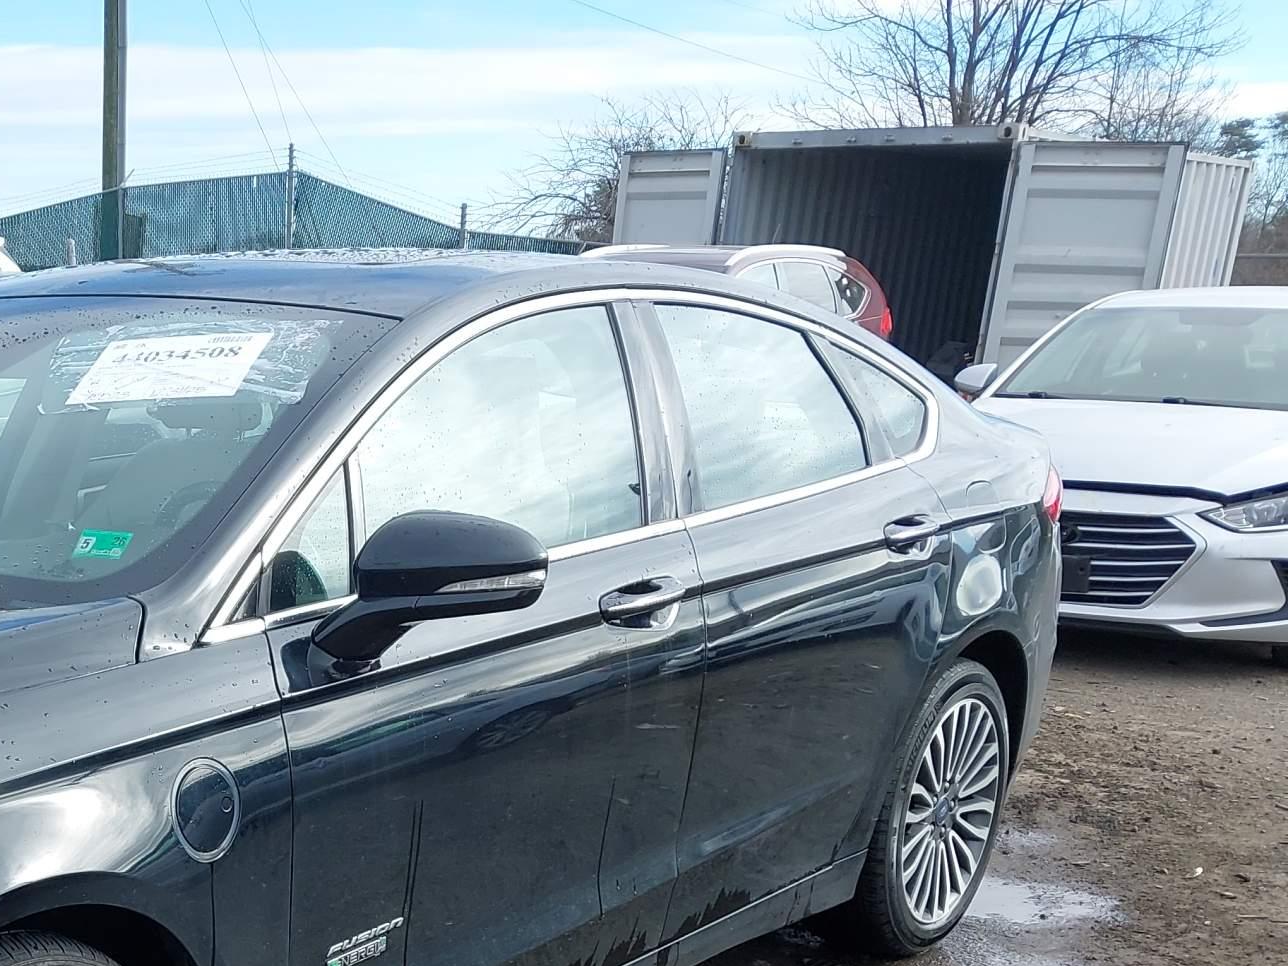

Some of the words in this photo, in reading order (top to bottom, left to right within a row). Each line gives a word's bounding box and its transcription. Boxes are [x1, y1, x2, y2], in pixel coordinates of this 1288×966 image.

[80, 538, 93, 549] 5
[113, 536, 127, 546] 26
[327, 917, 405, 957] FUSION
